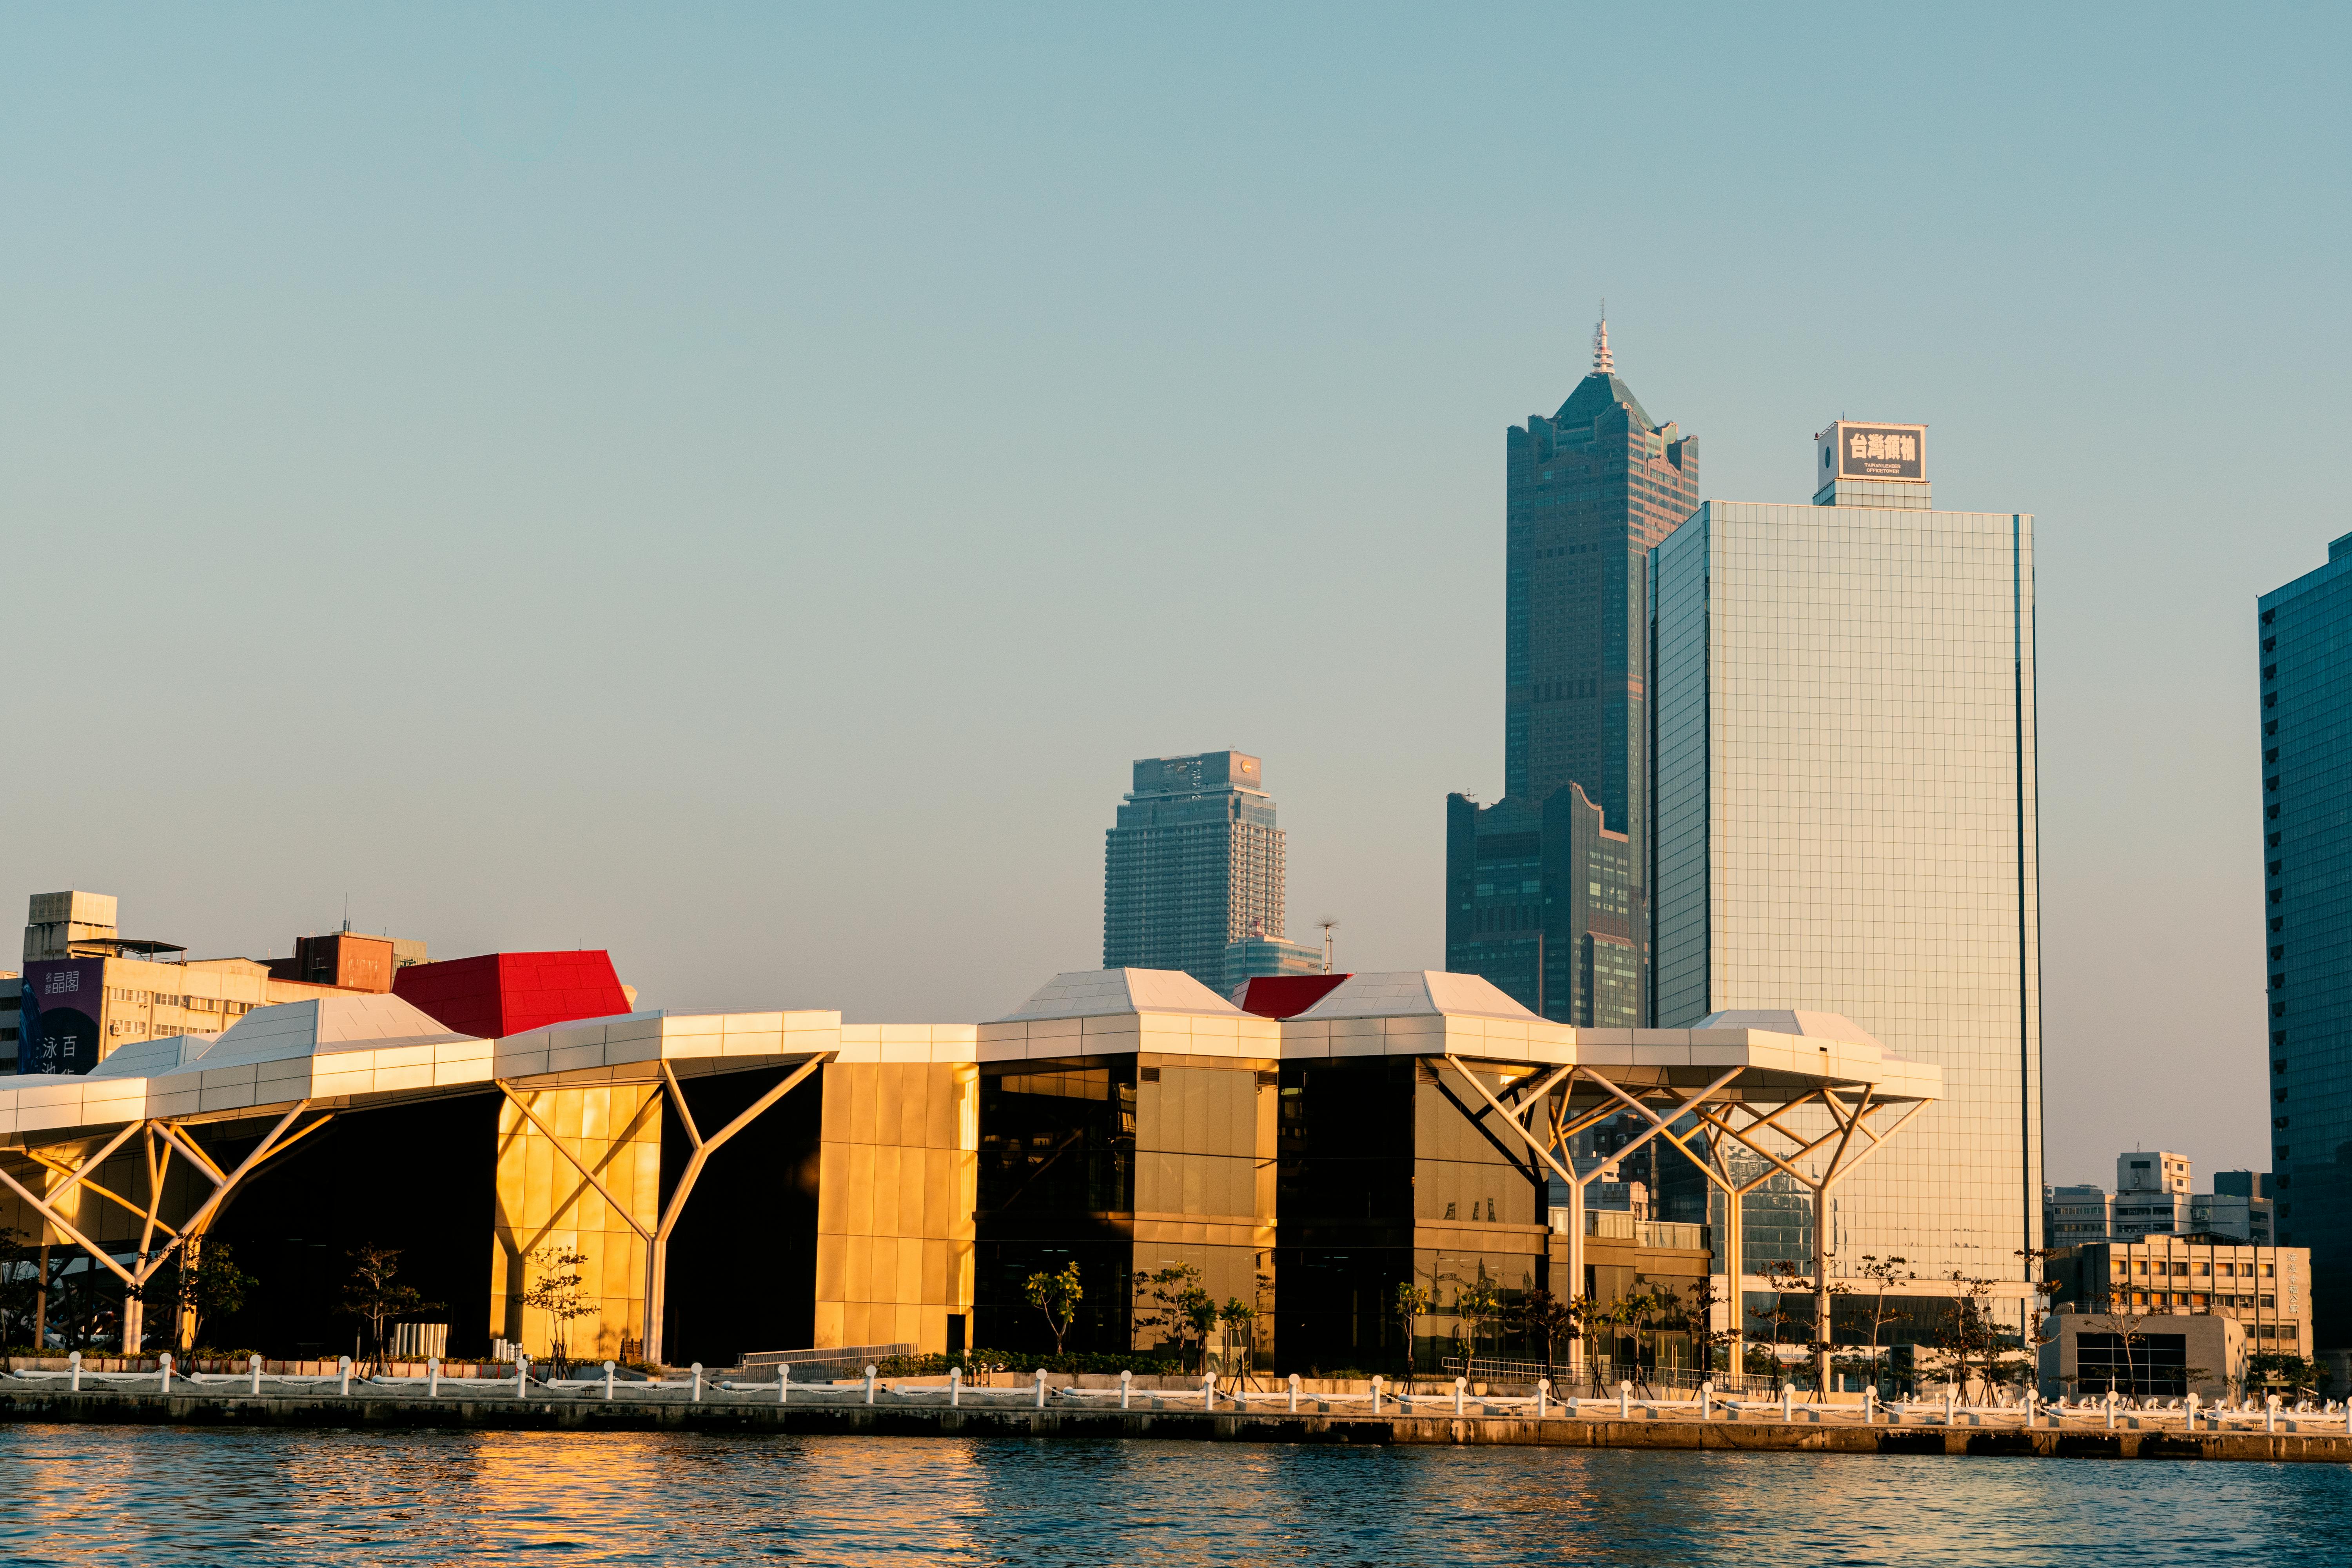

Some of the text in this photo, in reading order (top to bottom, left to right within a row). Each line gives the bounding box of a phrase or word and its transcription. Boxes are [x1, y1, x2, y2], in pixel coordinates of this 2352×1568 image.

[1850, 433, 1915, 461] 台灣領袖
[62, 1036, 77, 1075] 百
